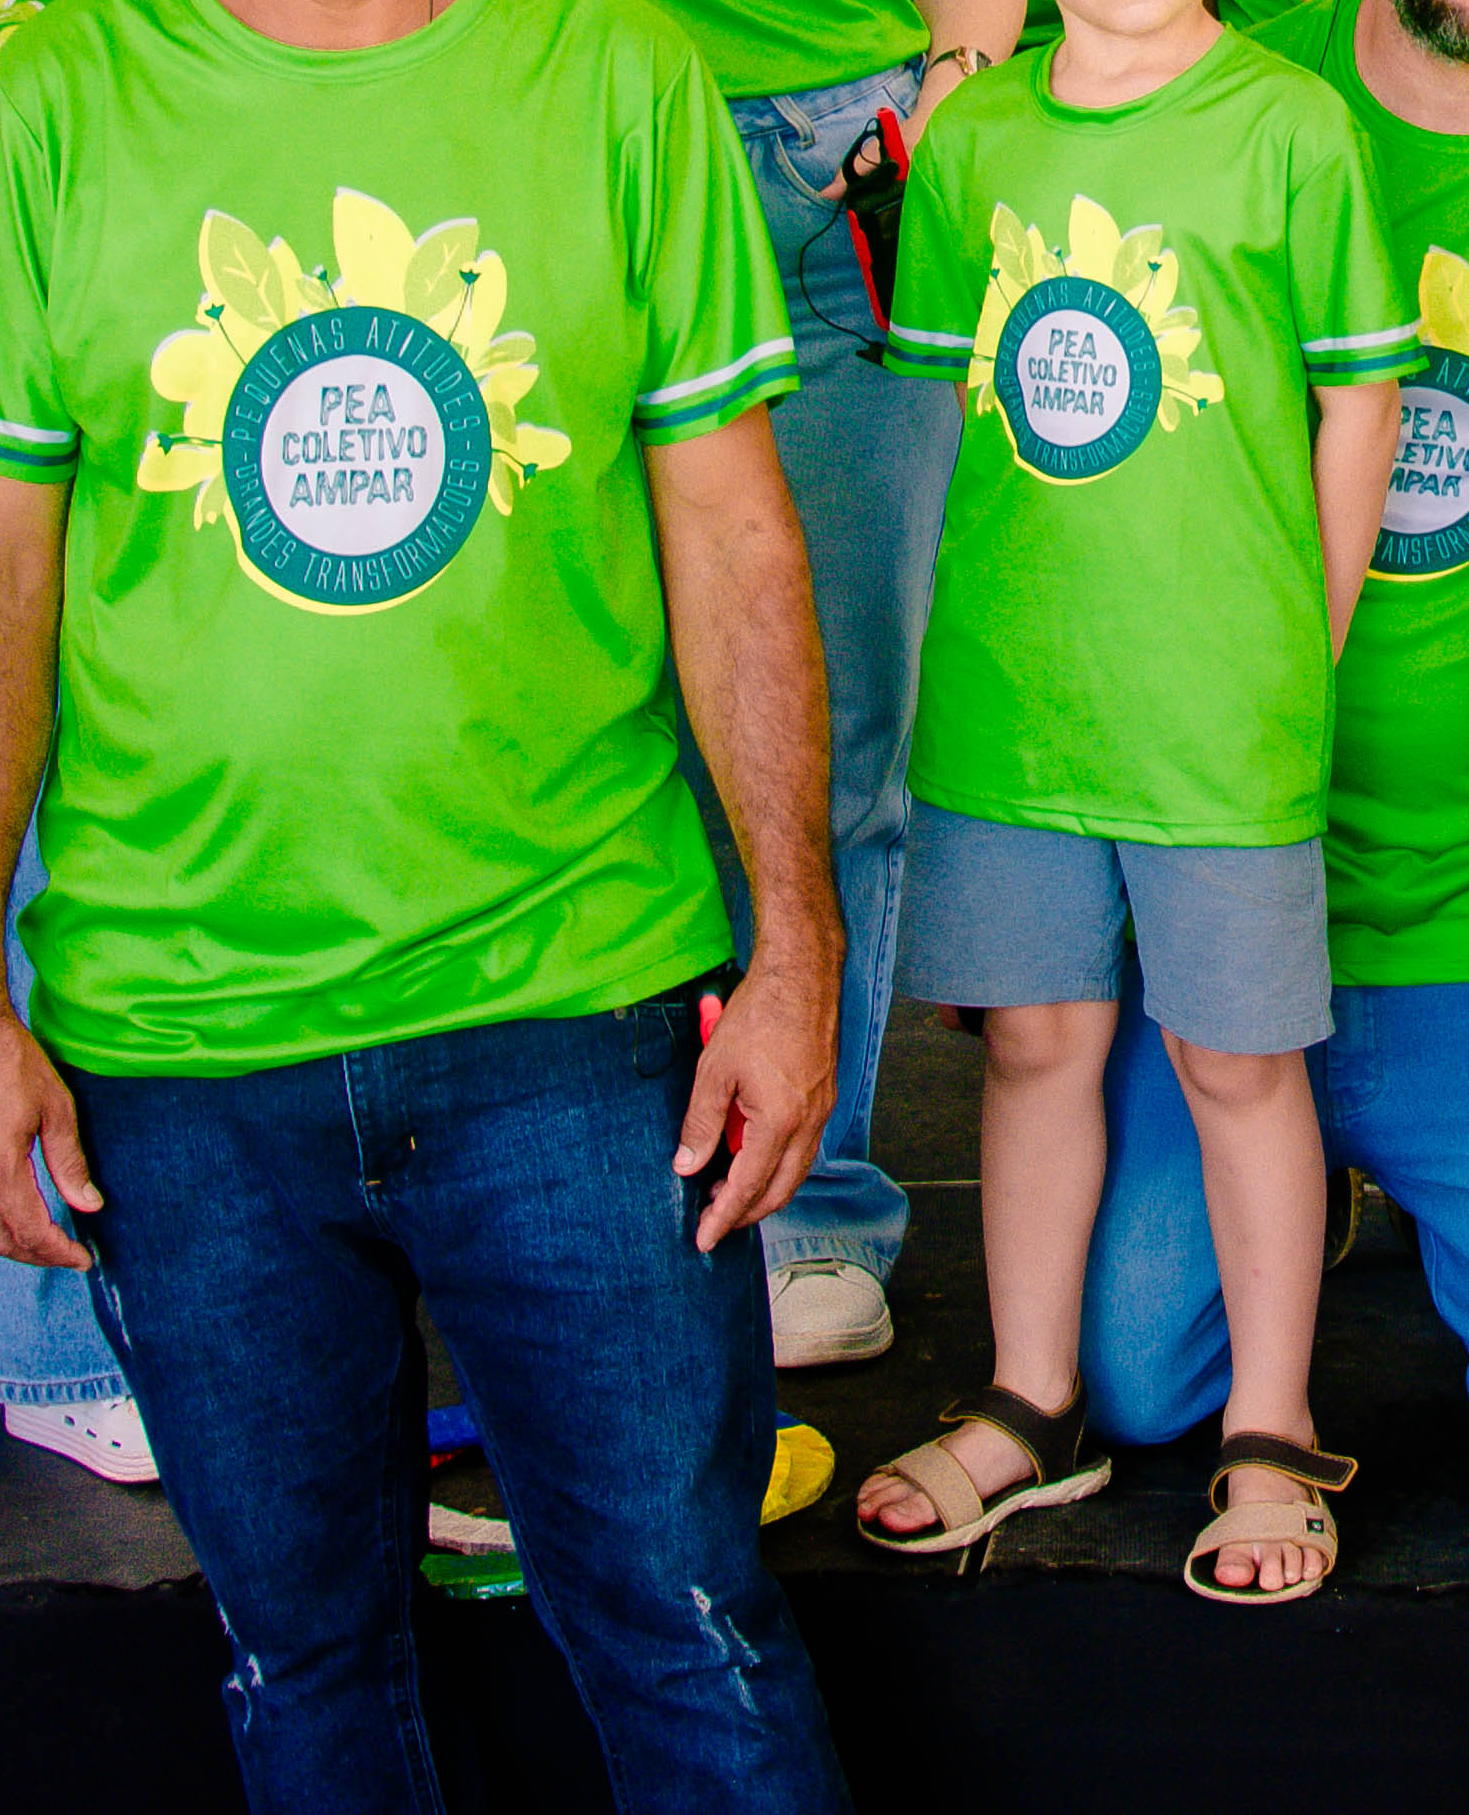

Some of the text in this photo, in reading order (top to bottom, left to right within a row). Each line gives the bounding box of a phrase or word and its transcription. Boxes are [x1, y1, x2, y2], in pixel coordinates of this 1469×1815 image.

[1048, 329, 1097, 360] PEA
[1083, 286, 1156, 370] ATITUDES
[231, 316, 481, 442] PEQUENAS ATITUDES
[1027, 357, 1117, 387] COLETIVO
[319, 384, 397, 425] PEA
[1031, 385, 1104, 415] AMPAR
[282, 425, 428, 466] COLETIVO
[289, 467, 415, 508] AMPAR
[234, 461, 297, 569] GRANDES
